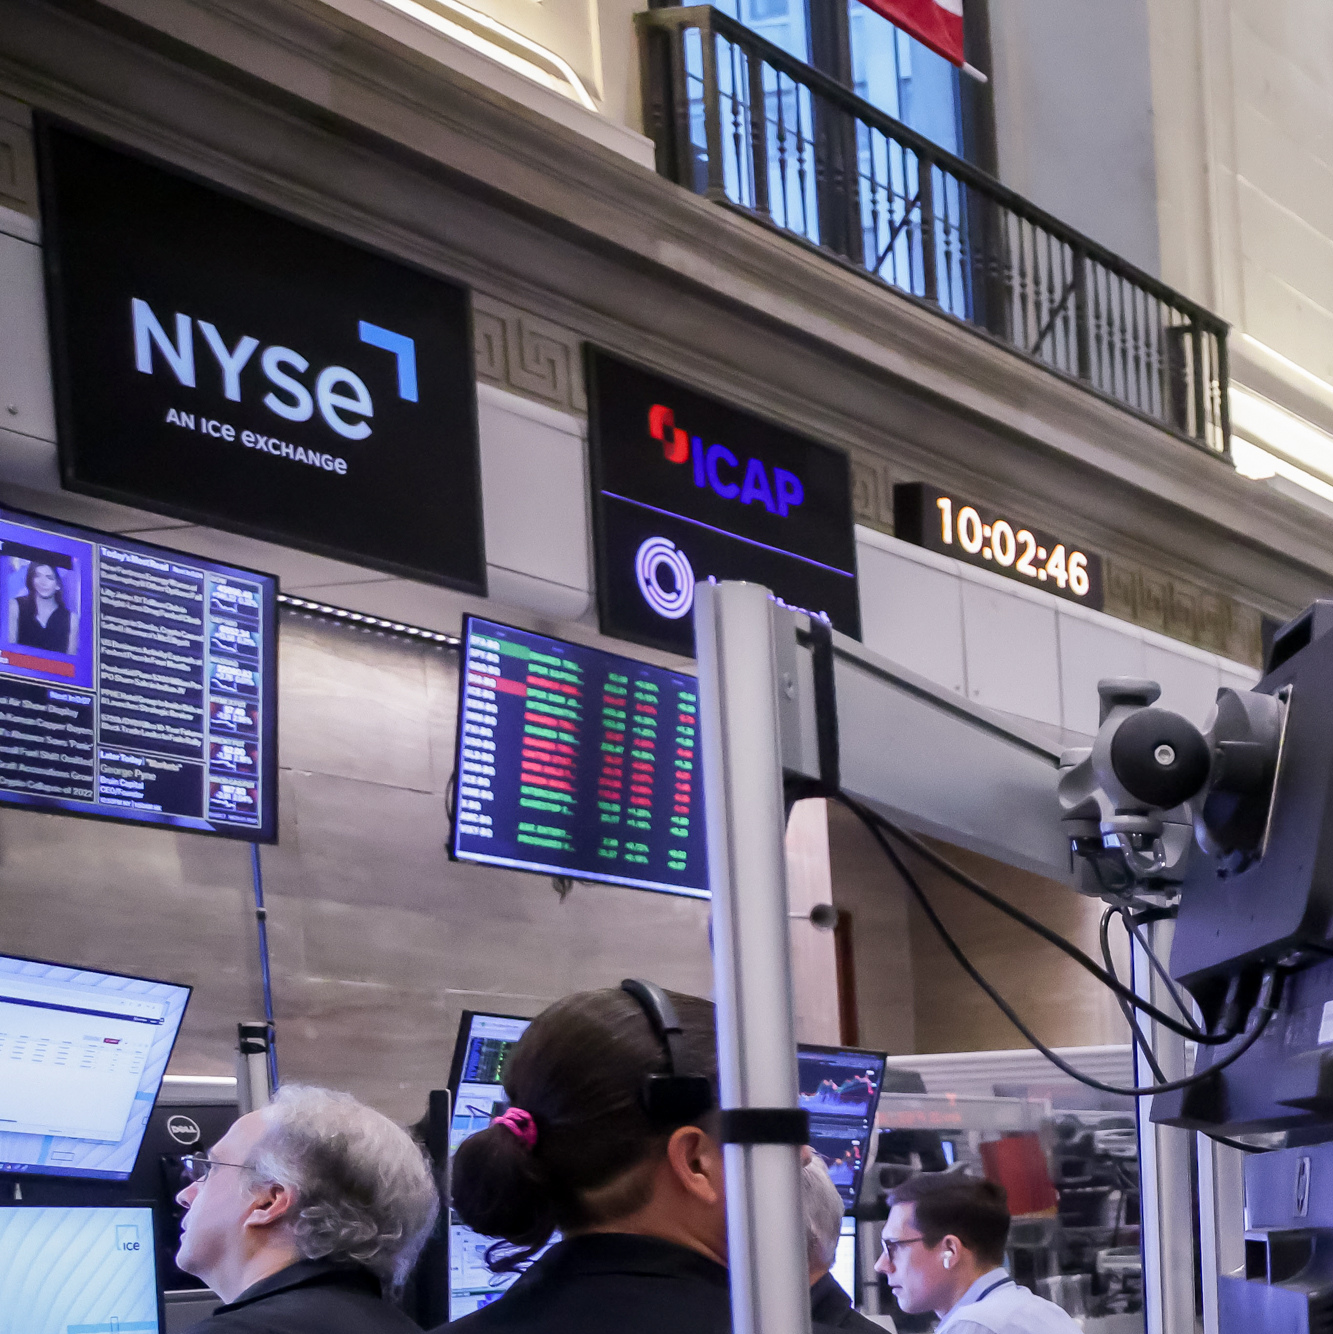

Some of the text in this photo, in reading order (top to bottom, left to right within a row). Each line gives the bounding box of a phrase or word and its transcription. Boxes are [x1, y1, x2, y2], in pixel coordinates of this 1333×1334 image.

[165, 408, 196, 430] AN
[690, 436, 805, 518] ICAP
[937, 497, 1091, 597] 10:02:46
